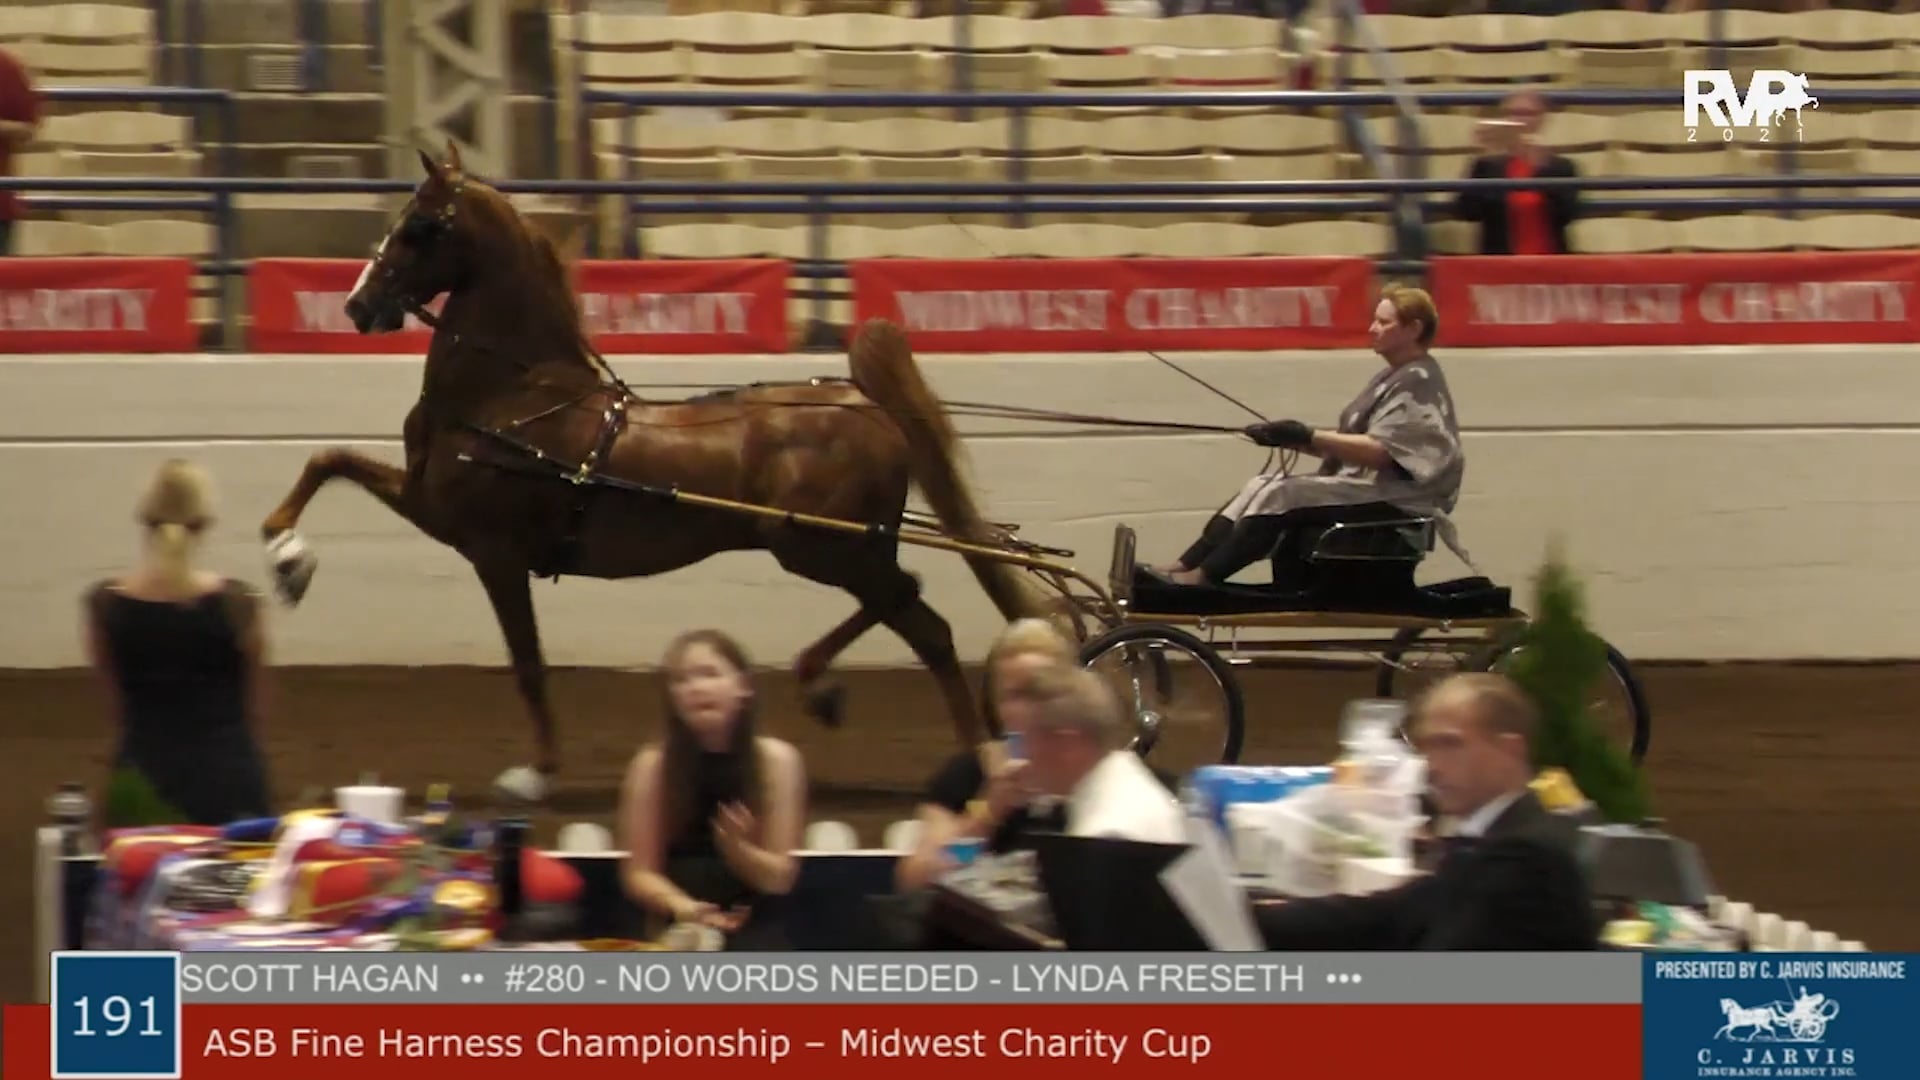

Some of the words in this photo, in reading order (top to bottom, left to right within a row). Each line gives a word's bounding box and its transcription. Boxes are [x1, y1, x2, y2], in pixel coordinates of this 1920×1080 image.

[0, 289, 154, 331] ARITY
[577, 292, 757, 335] HARITY
[894, 290, 1113, 331] MIDWEST
[1124, 286, 1338, 330] CHARITY
[1468, 284, 1688, 324] MIDWEST
